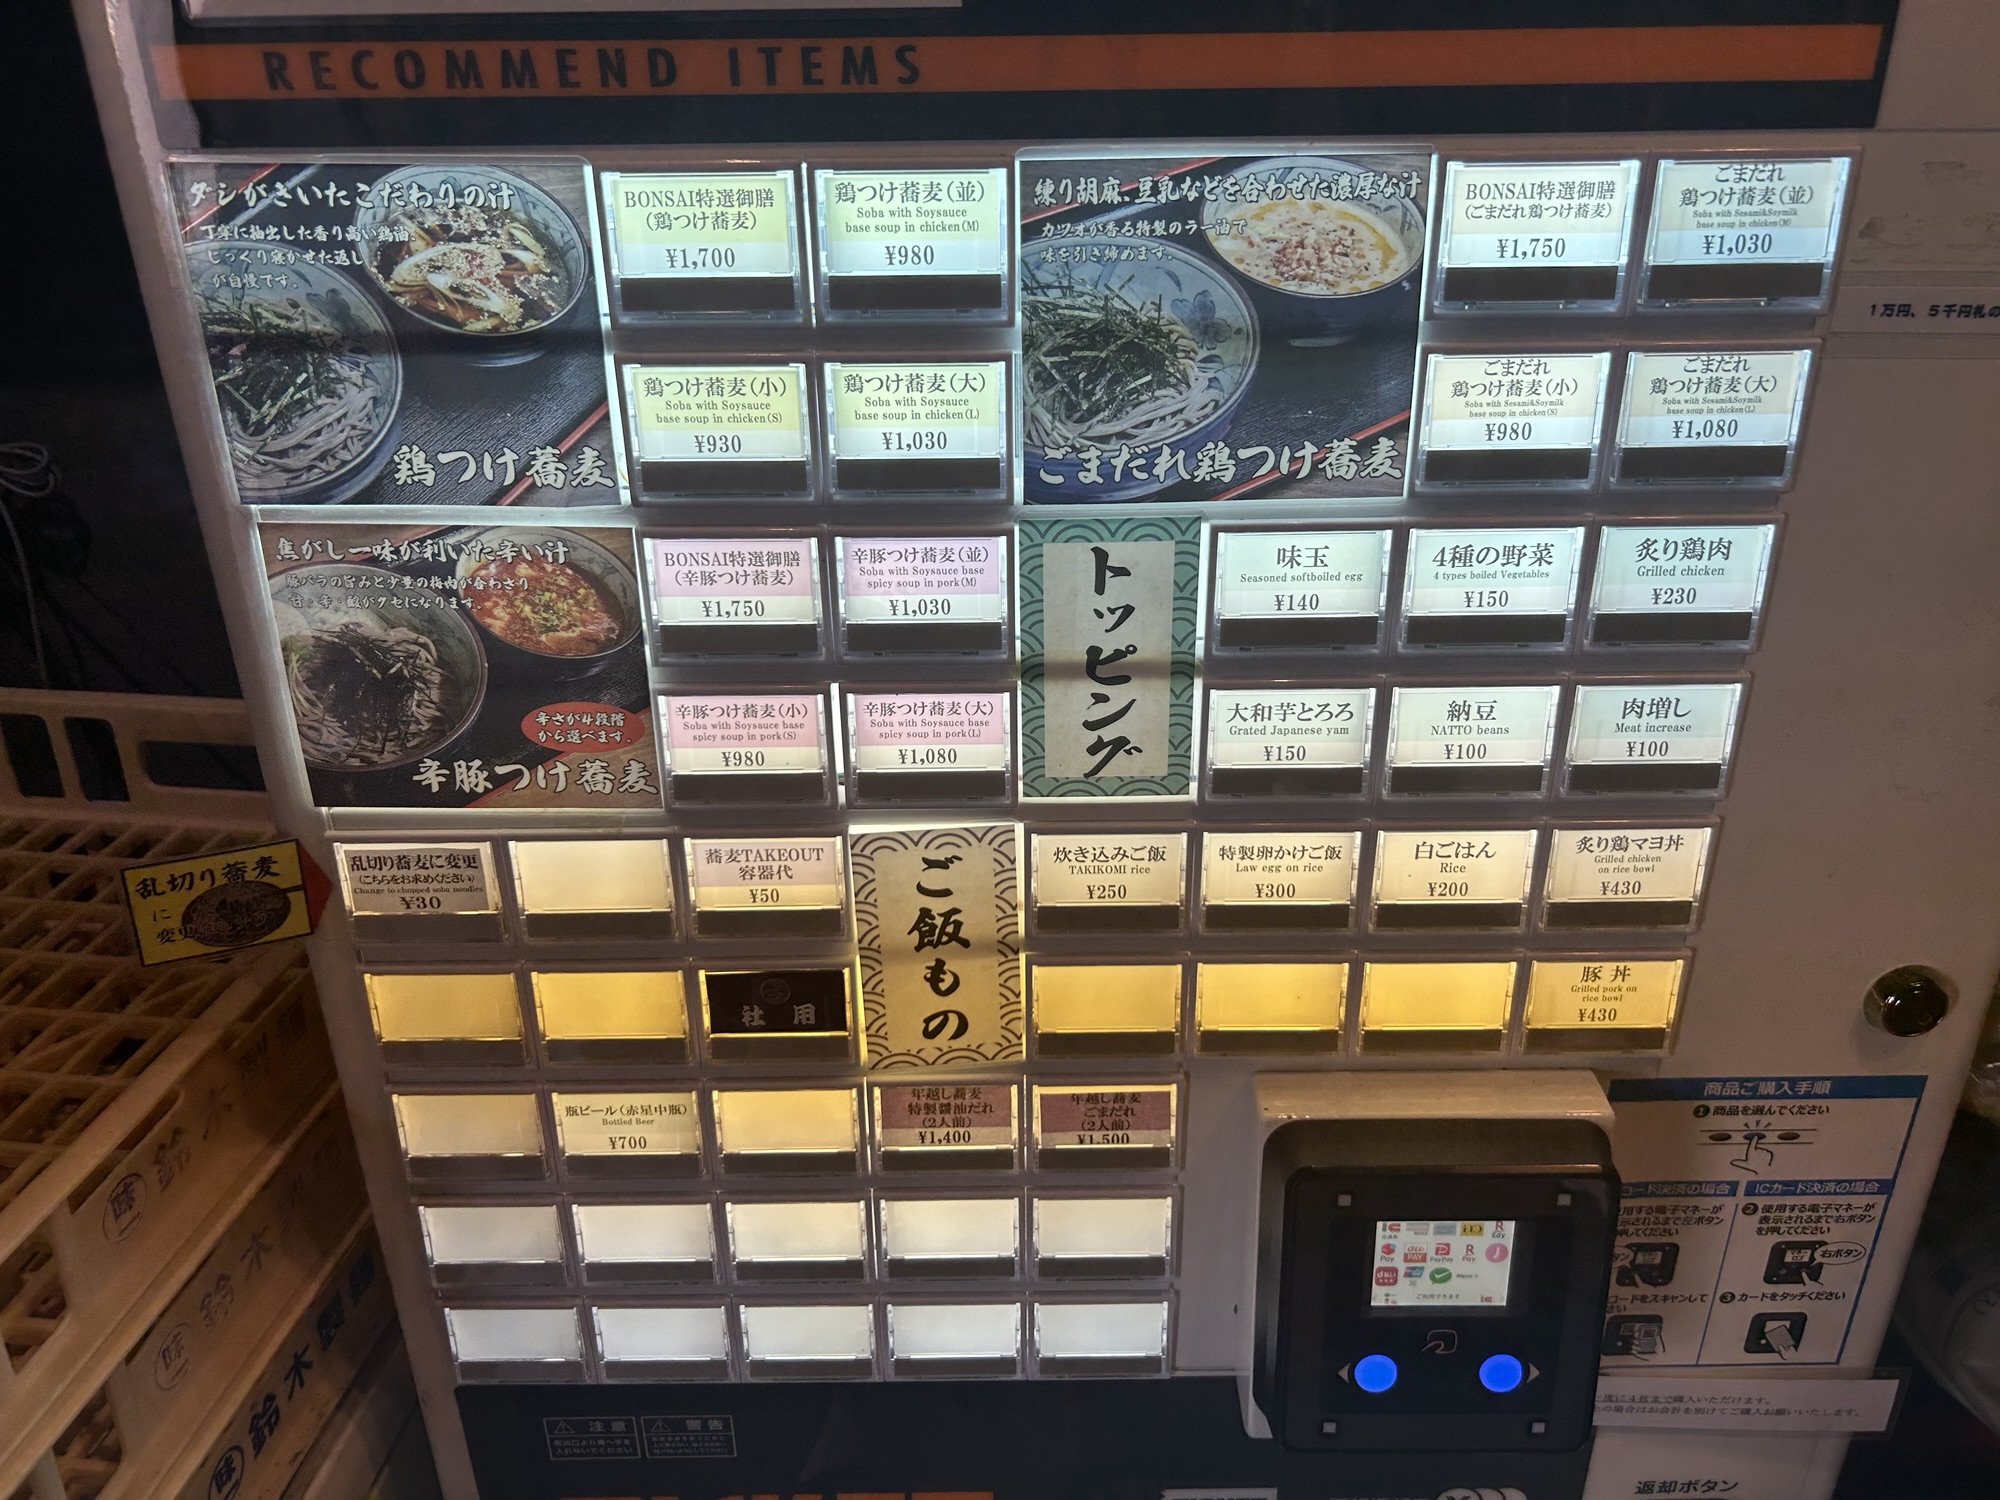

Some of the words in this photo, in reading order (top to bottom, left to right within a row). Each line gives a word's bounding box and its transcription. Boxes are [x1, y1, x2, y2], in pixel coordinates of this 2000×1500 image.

[263, 47, 677, 91] RECOMMEND
[728, 44, 919, 87] ITEMS
[1715, 164, 1785, 183] ごまだれ
[189, 181, 514, 210] ダシがきいたこだわりの汁
[1033, 172, 1422, 204] 練り胡麻、豆乳などを合わせた濃厚な汁
[1466, 180, 1616, 200] BONSAI特選御膳
[625, 189, 774, 208] BONSAI特選御膳
[857, 208, 884, 218] Soba
[889, 207, 912, 217] with
[916, 207, 967, 218] Soysauce
[1040, 219, 1248, 239] カツオが香る特製のラー油で
[1497, 238, 1566, 260] ¥1,750
[1702, 234, 1772, 256] ¥1,030
[207, 249, 364, 266] じっくり寝かせた返し
[666, 248, 735, 269] ¥1,700
[885, 245, 934, 265] ¥980
[1040, 245, 1175, 264] 味を引き締めます。
[212, 272, 298, 290] が自慢です。
[1484, 359, 1551, 376] ごまだれ
[1684, 356, 1750, 373] ごまだれ
[1464, 400, 1483, 408] Soba
[1504, 399, 1563, 408] Sesami&Soymilk
[1485, 422, 1532, 441] ¥980
[1672, 419, 1738, 440] ¥1,080
[694, 435, 741, 453] ¥930
[882, 431, 947, 451] ¥1,030
[393, 444, 617, 489] 鶏つけ蕎麦
[1039, 436, 1403, 485] ごまだれ鶏つけ蕎麦
[276, 538, 569, 564] 焦がし一味が利いた辛い汁
[1277, 545, 1329, 569] 味玉
[1432, 543, 1554, 568] 4種の野菜
[1635, 537, 1732, 562] 炙り鶏肉
[664, 551, 800, 568] BONSAI特選御膳
[1240, 573, 1287, 582] Seasoned
[1291, 572, 1340, 581] softboiled
[1345, 573, 1363, 582] egg
[1433, 572, 1439, 580] 4
[1442, 571, 1466, 580] types
[1470, 571, 1497, 579] boiled
[1501, 570, 1549, 579] Vegetables
[1637, 566, 1675, 576] Grilled
[1681, 565, 1724, 576] chicken
[1274, 594, 1319, 610] ¥140
[1464, 590, 1508, 607] ¥150
[1652, 587, 1696, 605] ¥230
[702, 600, 764, 618] ¥1,750
[890, 599, 950, 616] ¥1,030
[1082, 546, 1142, 777] トッピング
[1226, 702, 1354, 723] 大和芋とろろ
[1447, 700, 1497, 722] 納豆
[1622, 697, 1691, 719] 肉増し
[535, 713, 625, 727] 辛さが4段階
[1614, 723, 1641, 733] Meat
[1645, 723, 1691, 732] increase
[538, 730, 632, 743] から選べます。
[1230, 726, 1266, 735] Grated
[1271, 726, 1322, 736] Japanese
[1326, 727, 1349, 735] yam
[1431, 725, 1472, 735] NATTO
[1477, 725, 1509, 734] beans
[899, 748, 957, 765] ¥1,080
[1263, 746, 1306, 761] ¥150
[1444, 744, 1487, 759] ¥100
[1626, 741, 1668, 756] ¥100
[722, 751, 765, 766] ¥980
[413, 758, 659, 795] 辛豚つけ蕎麦
[1415, 841, 1496, 859] 白ごはん
[1576, 835, 1684, 853] 炙り鶏マヨ丼
[705, 848, 824, 864] 蕎麦TAKEOUT
[1053, 846, 1167, 863] 炊き込みご飯
[1219, 845, 1342, 861] 特製卵かけご飯
[1594, 855, 1624, 863] Grilled
[1628, 854, 1661, 862] chicken
[351, 853, 479, 871] 乱切り蕎麦に変更
[1069, 865, 1126, 874] TAKIKOMI
[1131, 865, 1150, 874] rice
[1236, 863, 1258, 872] Law
[1262, 864, 1281, 872] egg
[1303, 863, 1323, 872] rice
[1440, 863, 1466, 873] Rice
[135, 855, 280, 900] 乱切り蕎麦
[739, 865, 793, 880] 容器代
[750, 889, 779, 903] ¥50
[1087, 884, 1127, 899] ¥250
[1255, 884, 1295, 898] ¥300
[1428, 882, 1468, 897] ¥200
[1600, 881, 1641, 895] ¥430
[400, 896, 441, 909] ¥30
[152, 908, 171, 922] に
[908, 855, 970, 1040] ご飯もの
[1580, 965, 1631, 983] 豚丼
[1578, 1008, 1617, 1022] ¥430
[911, 1087, 982, 1100] 年越し蕎麦
[1704, 1080, 1832, 1096] 商品ご購入手順
[1071, 1093, 1141, 1105] 年越し蕎麦
[1084, 1106, 1136, 1117] ごまだれ
[1713, 1104, 1829, 1116] 商品を選んでください
[609, 1136, 647, 1149] ¥700
[918, 1130, 971, 1144] ¥1,400
[1755, 1182, 1880, 1194] ICカード決済の場合
[1761, 1203, 1877, 1214] 使用する電子マネーが
[1758, 1215, 1875, 1225] 表示されるまで右ボタン
[1738, 1291, 1846, 1302] カードをタッチください
[248, 1248, 374, 1458] 鈴木製
[1634, 1480, 1738, 1494] 返却ボタン
